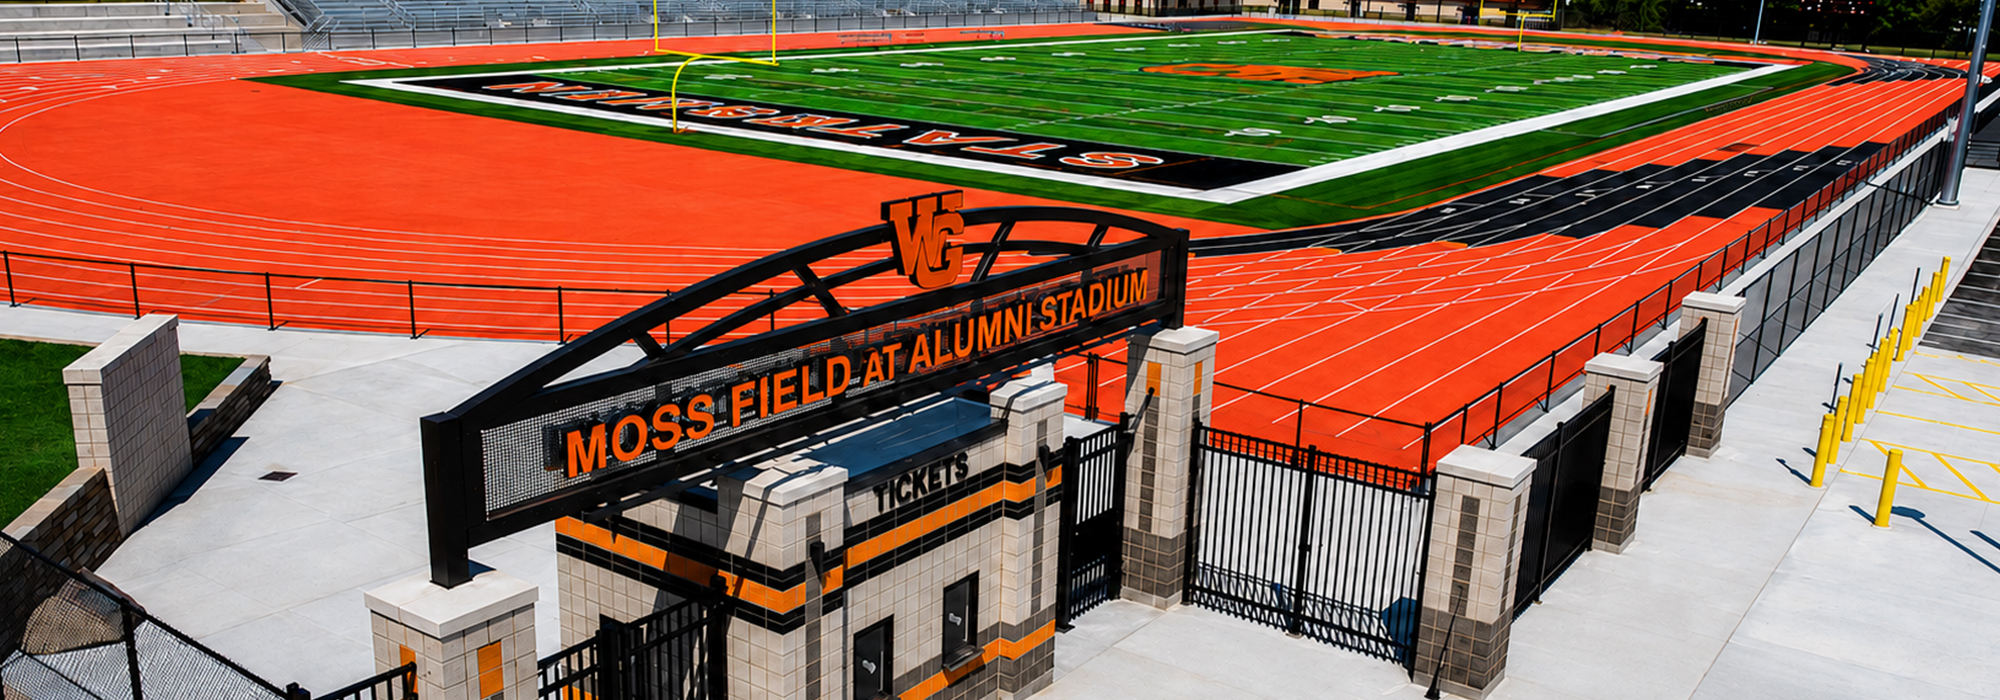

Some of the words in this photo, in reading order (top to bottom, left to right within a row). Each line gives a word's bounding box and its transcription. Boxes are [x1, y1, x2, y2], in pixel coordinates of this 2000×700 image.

[881, 189, 965, 289] WG
[566, 393, 716, 479] MOSS
[731, 354, 852, 428] FIELD
[863, 341, 902, 388] AT
[908, 301, 1033, 375] ALUMNI
[1039, 269, 1148, 332] STADIUM
[873, 451, 969, 514] TICKETS
